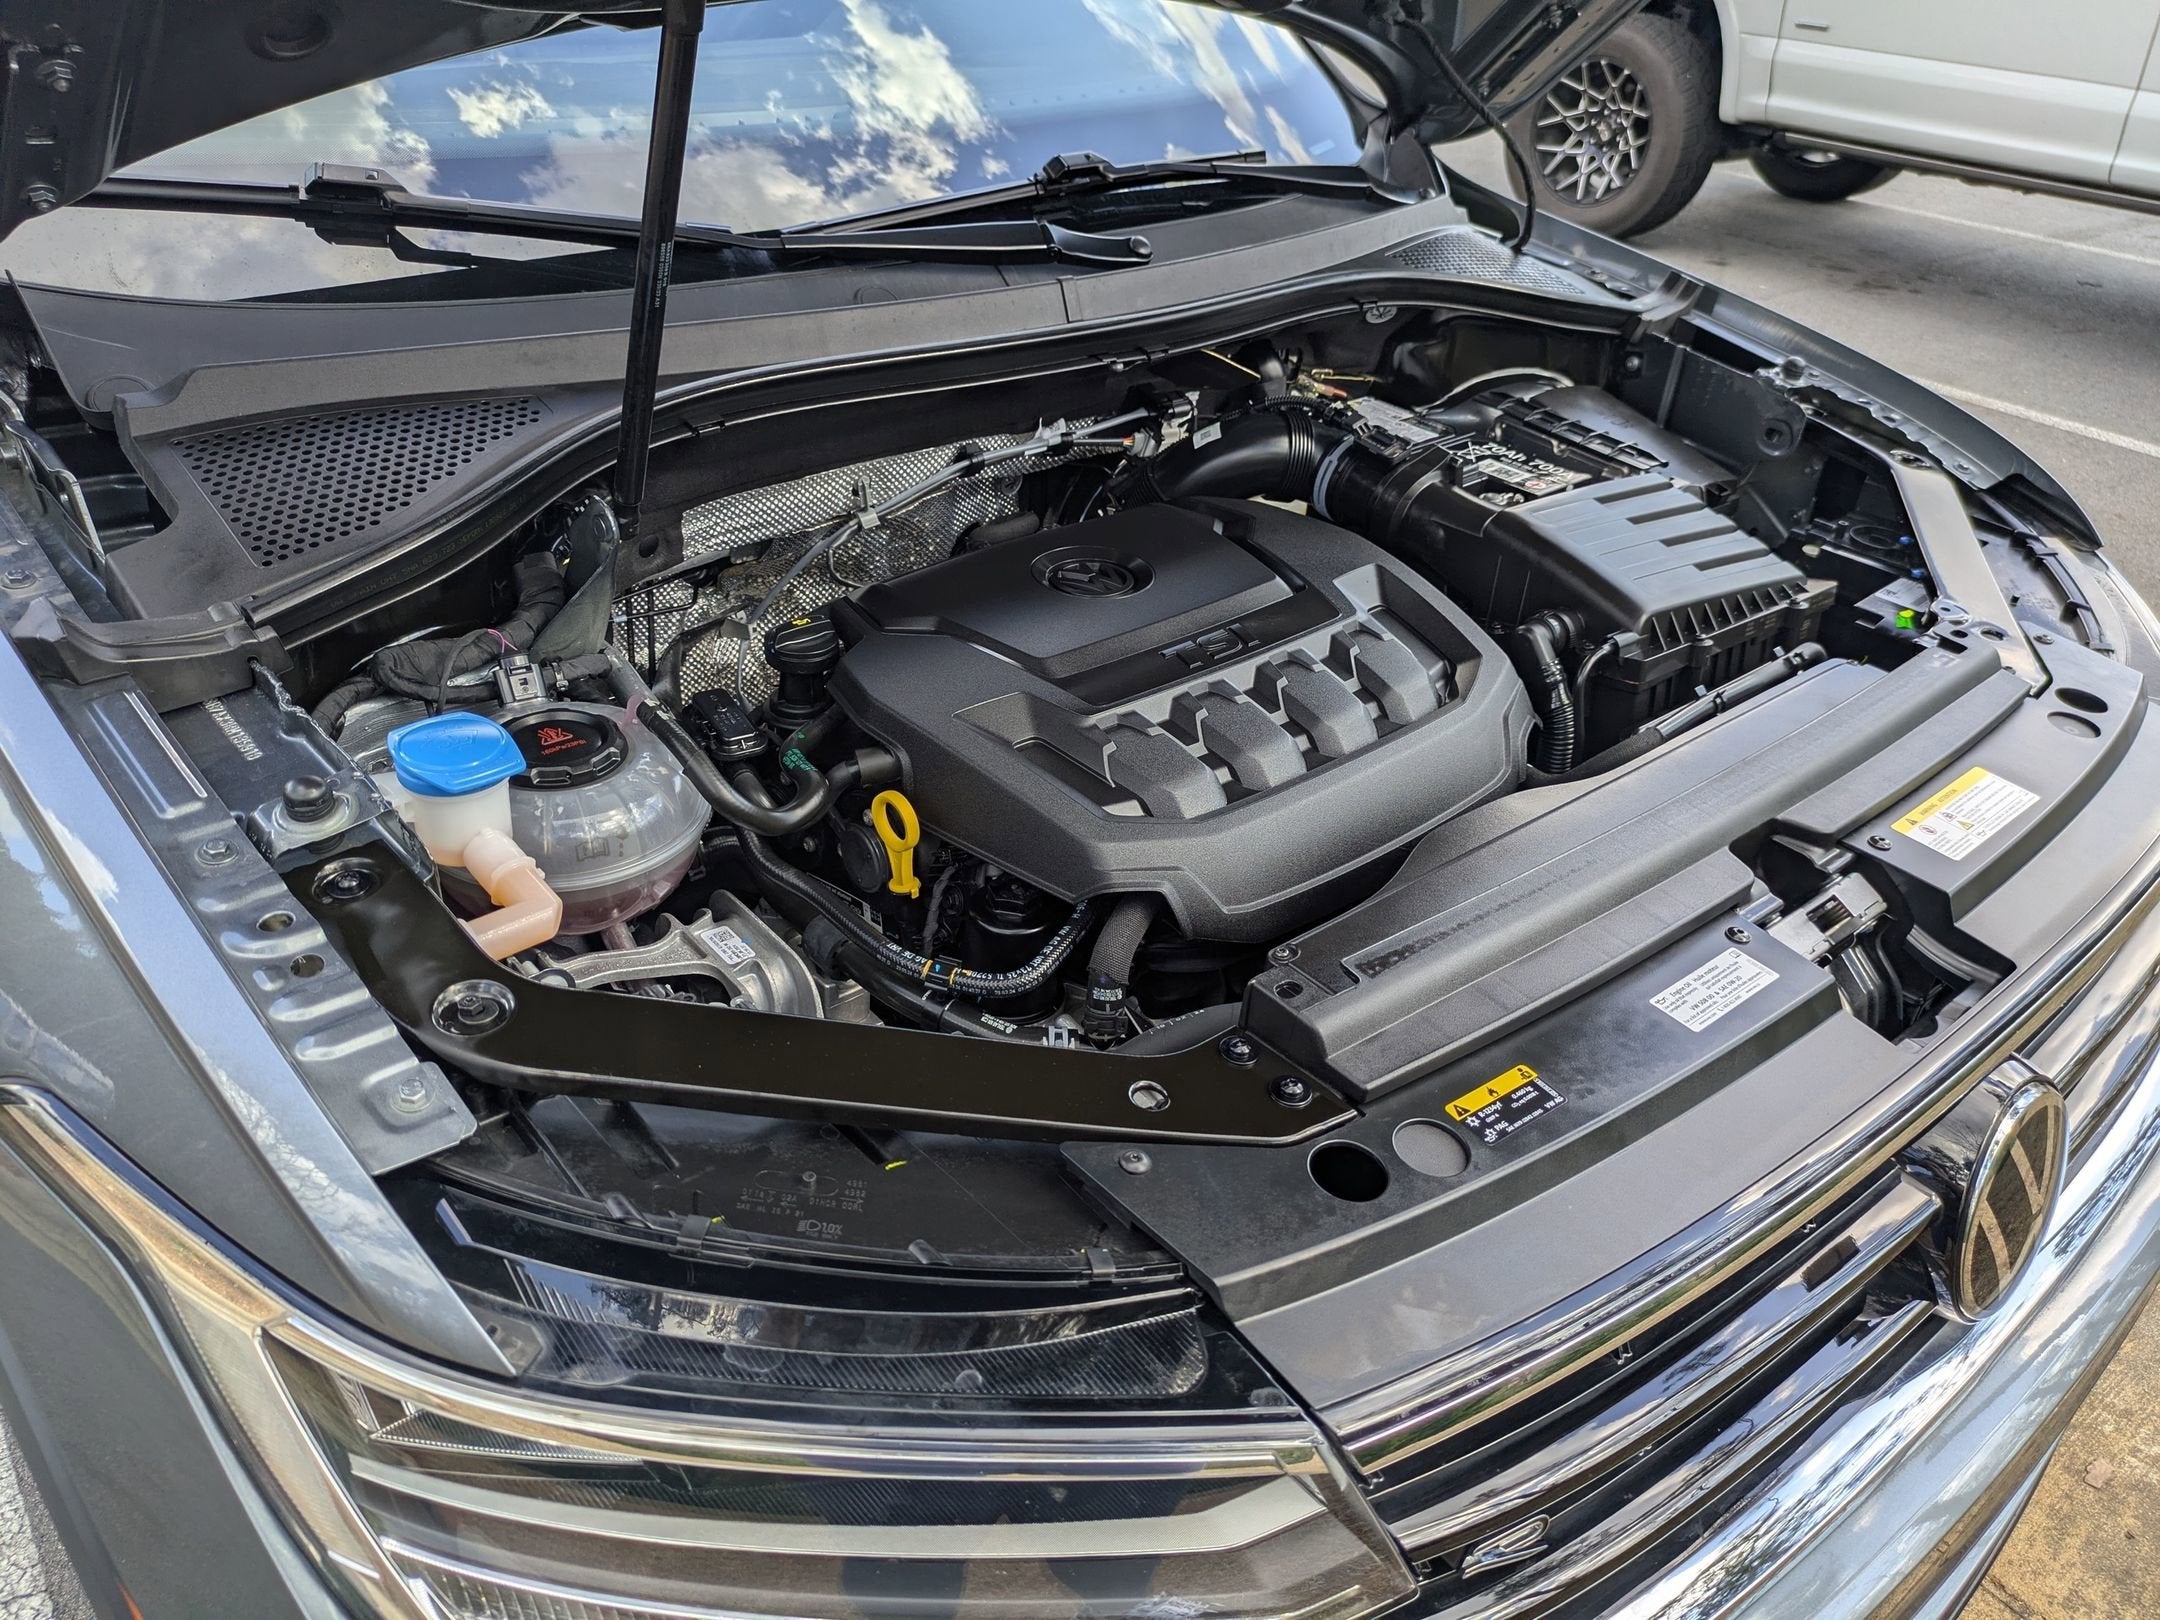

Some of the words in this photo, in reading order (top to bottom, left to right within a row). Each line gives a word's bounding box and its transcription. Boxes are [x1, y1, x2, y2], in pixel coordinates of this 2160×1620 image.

[1481, 441, 1527, 462] 70Ah
[1528, 459, 1575, 479] 700A
[1158, 622, 1261, 669] TSI
[886, 942, 902, 953] VRT
[1478, 1101, 1502, 1117] R-1234yf
[1494, 1120, 1509, 1131] PAG
